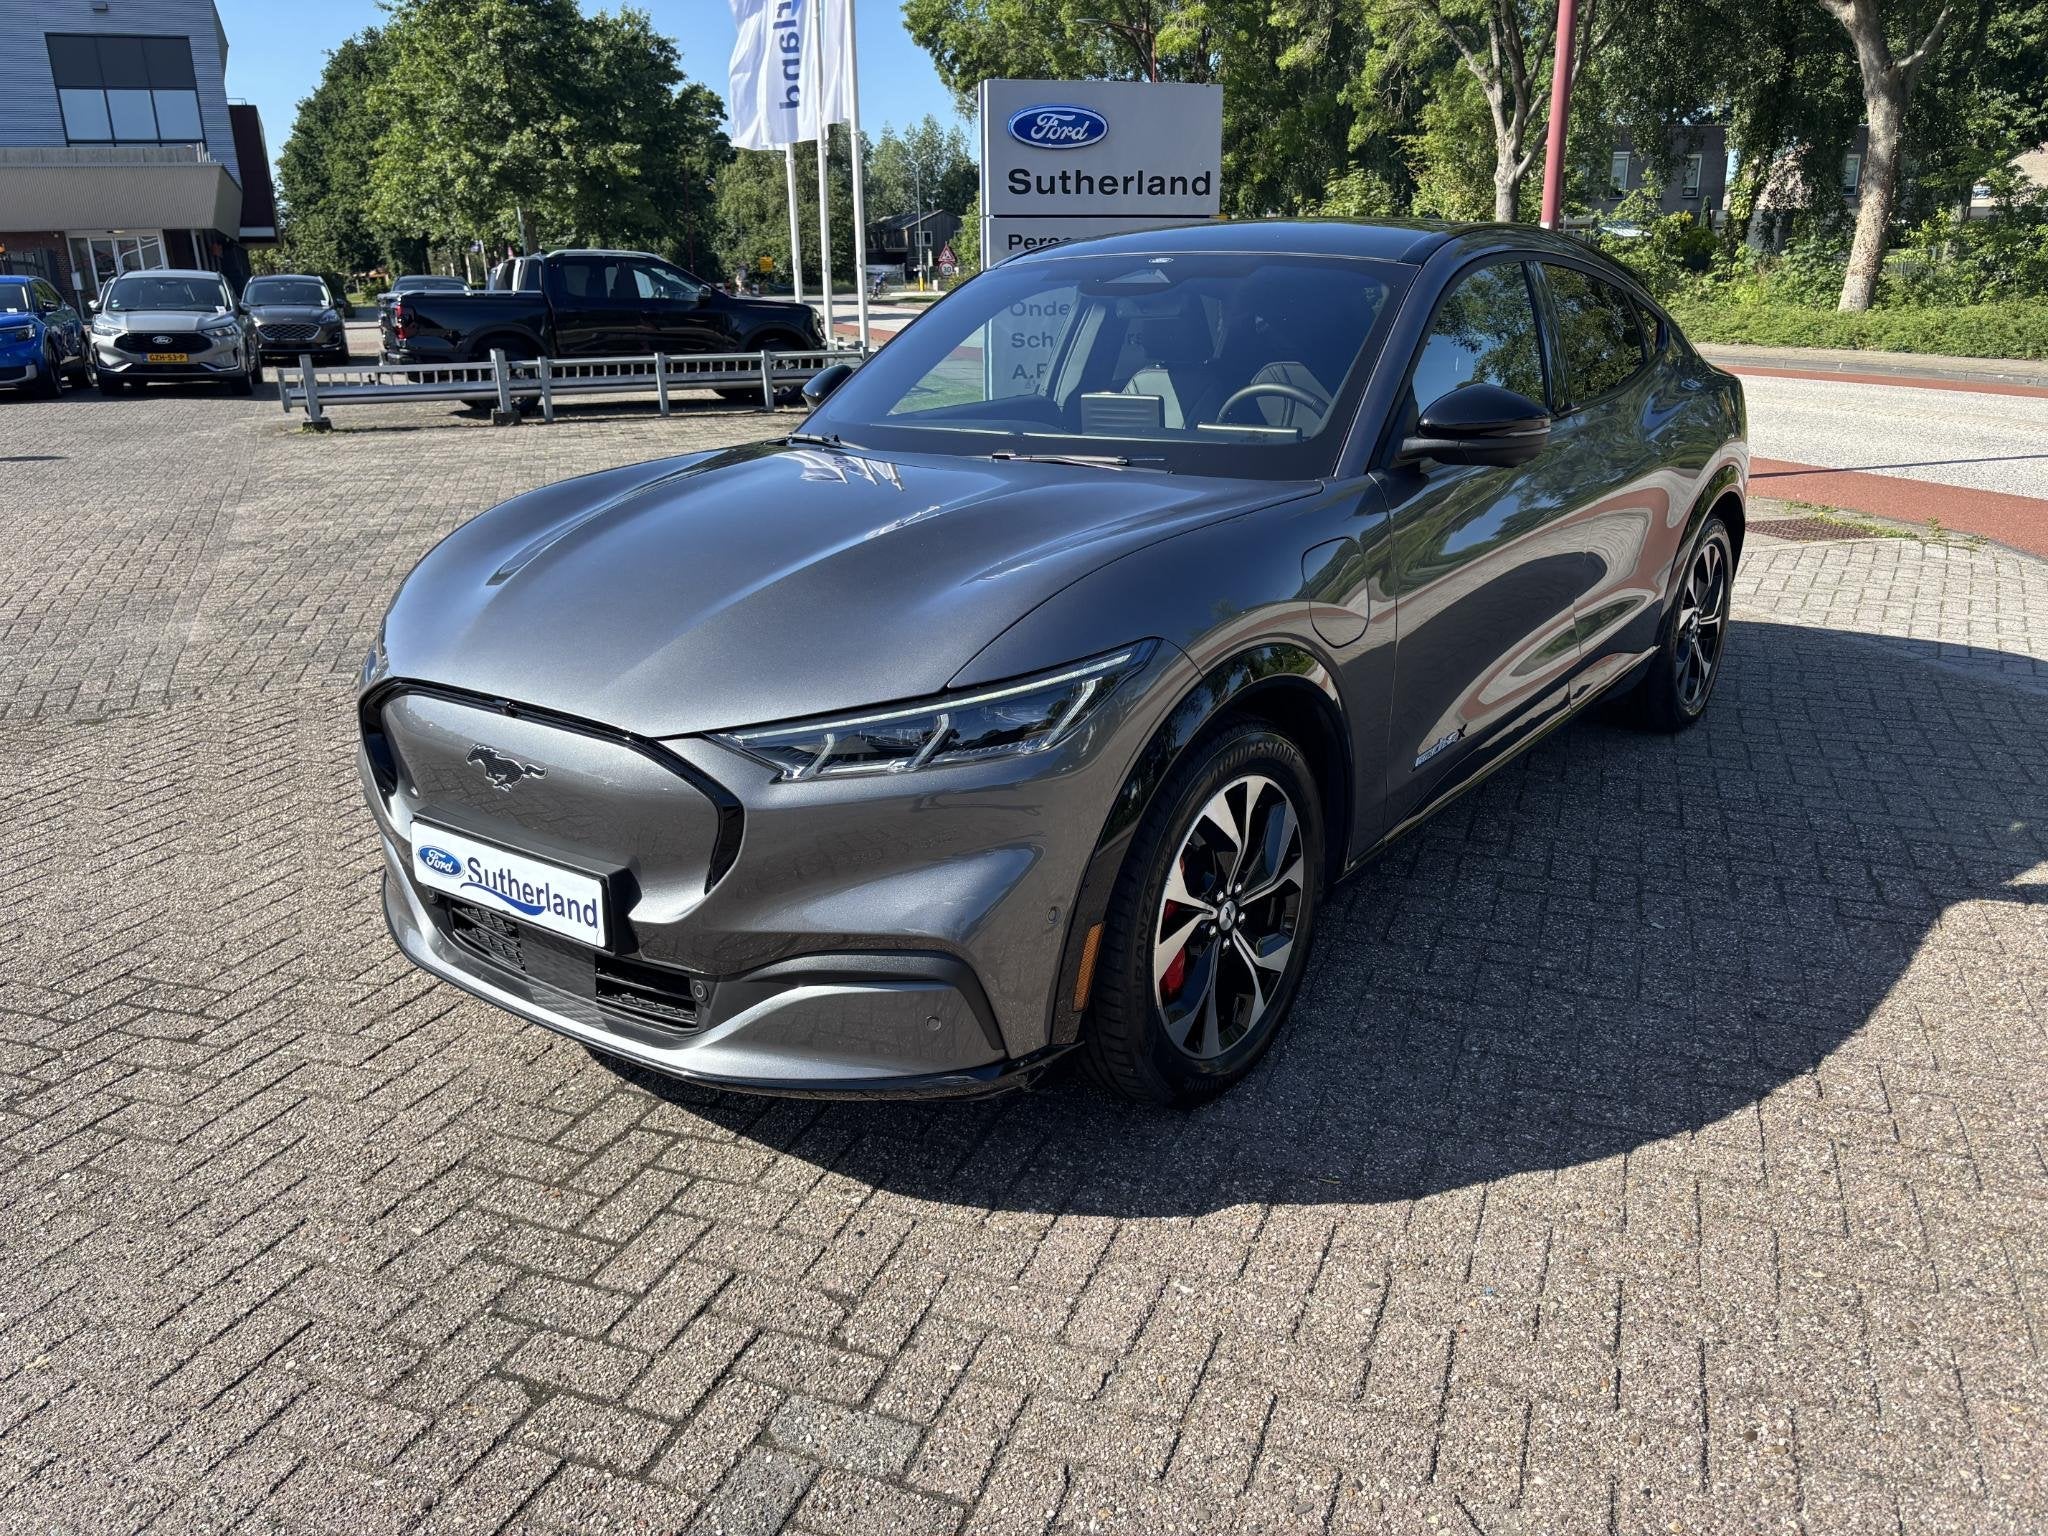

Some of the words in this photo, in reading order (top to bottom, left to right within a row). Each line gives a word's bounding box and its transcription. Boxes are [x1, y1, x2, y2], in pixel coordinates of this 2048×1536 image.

[1031, 113, 1089, 140] Ford
[1008, 169, 1211, 196] Sutherland
[1008, 233, 1072, 251] Per
[426, 849, 454, 873] Ford
[467, 857, 599, 928] Sutherland
